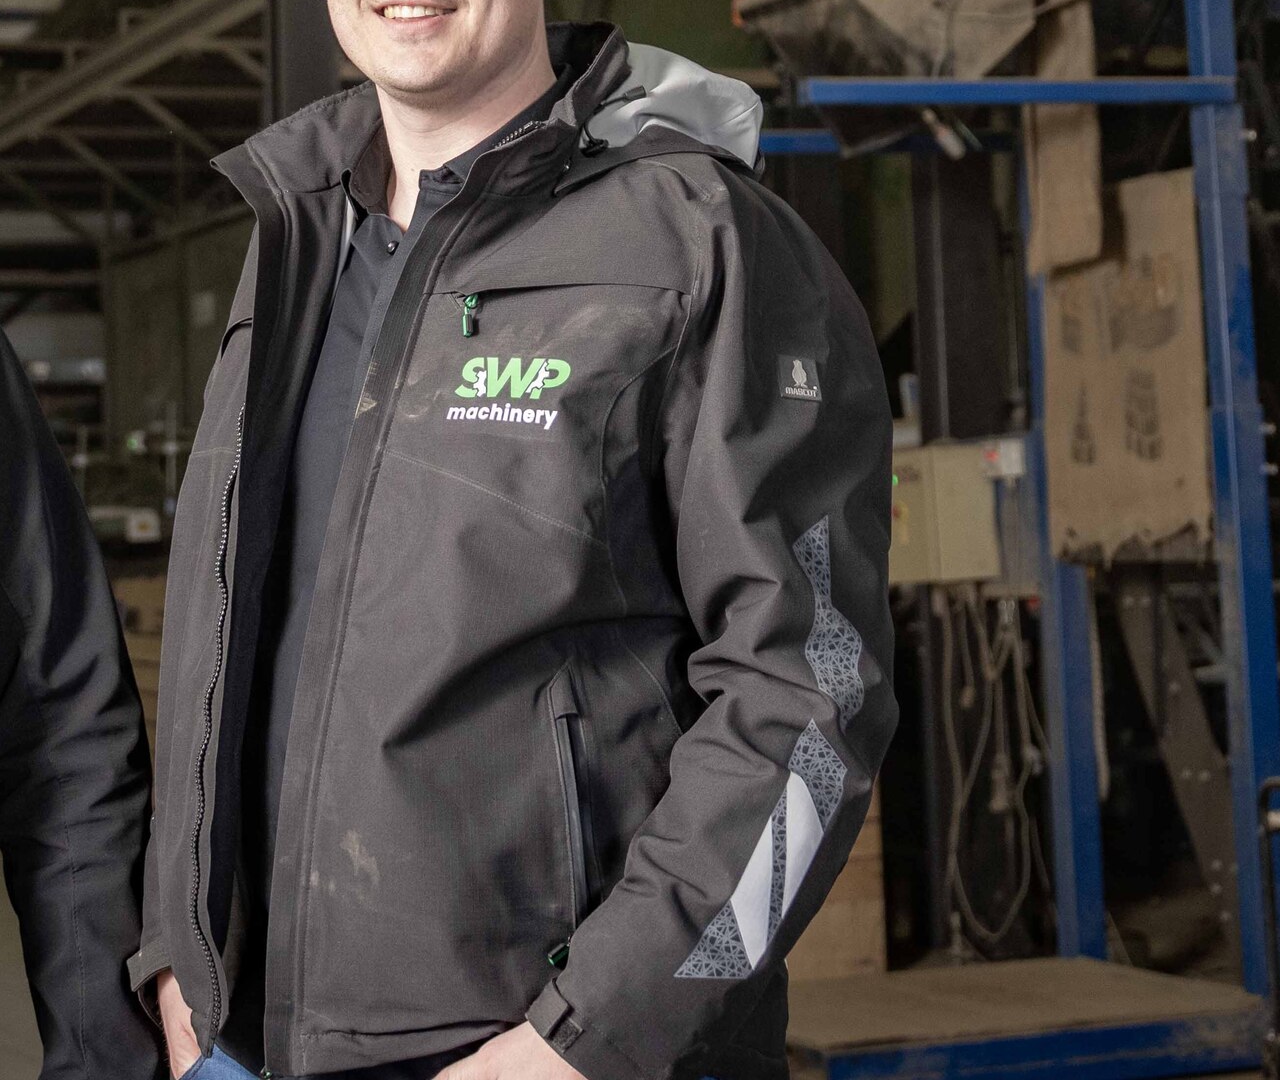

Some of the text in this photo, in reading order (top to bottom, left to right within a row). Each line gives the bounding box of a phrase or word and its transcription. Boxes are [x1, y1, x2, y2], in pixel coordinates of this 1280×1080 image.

[454, 357, 571, 400] SWP
[785, 386, 817, 398] MASCOT
[446, 402, 558, 430] machinery
